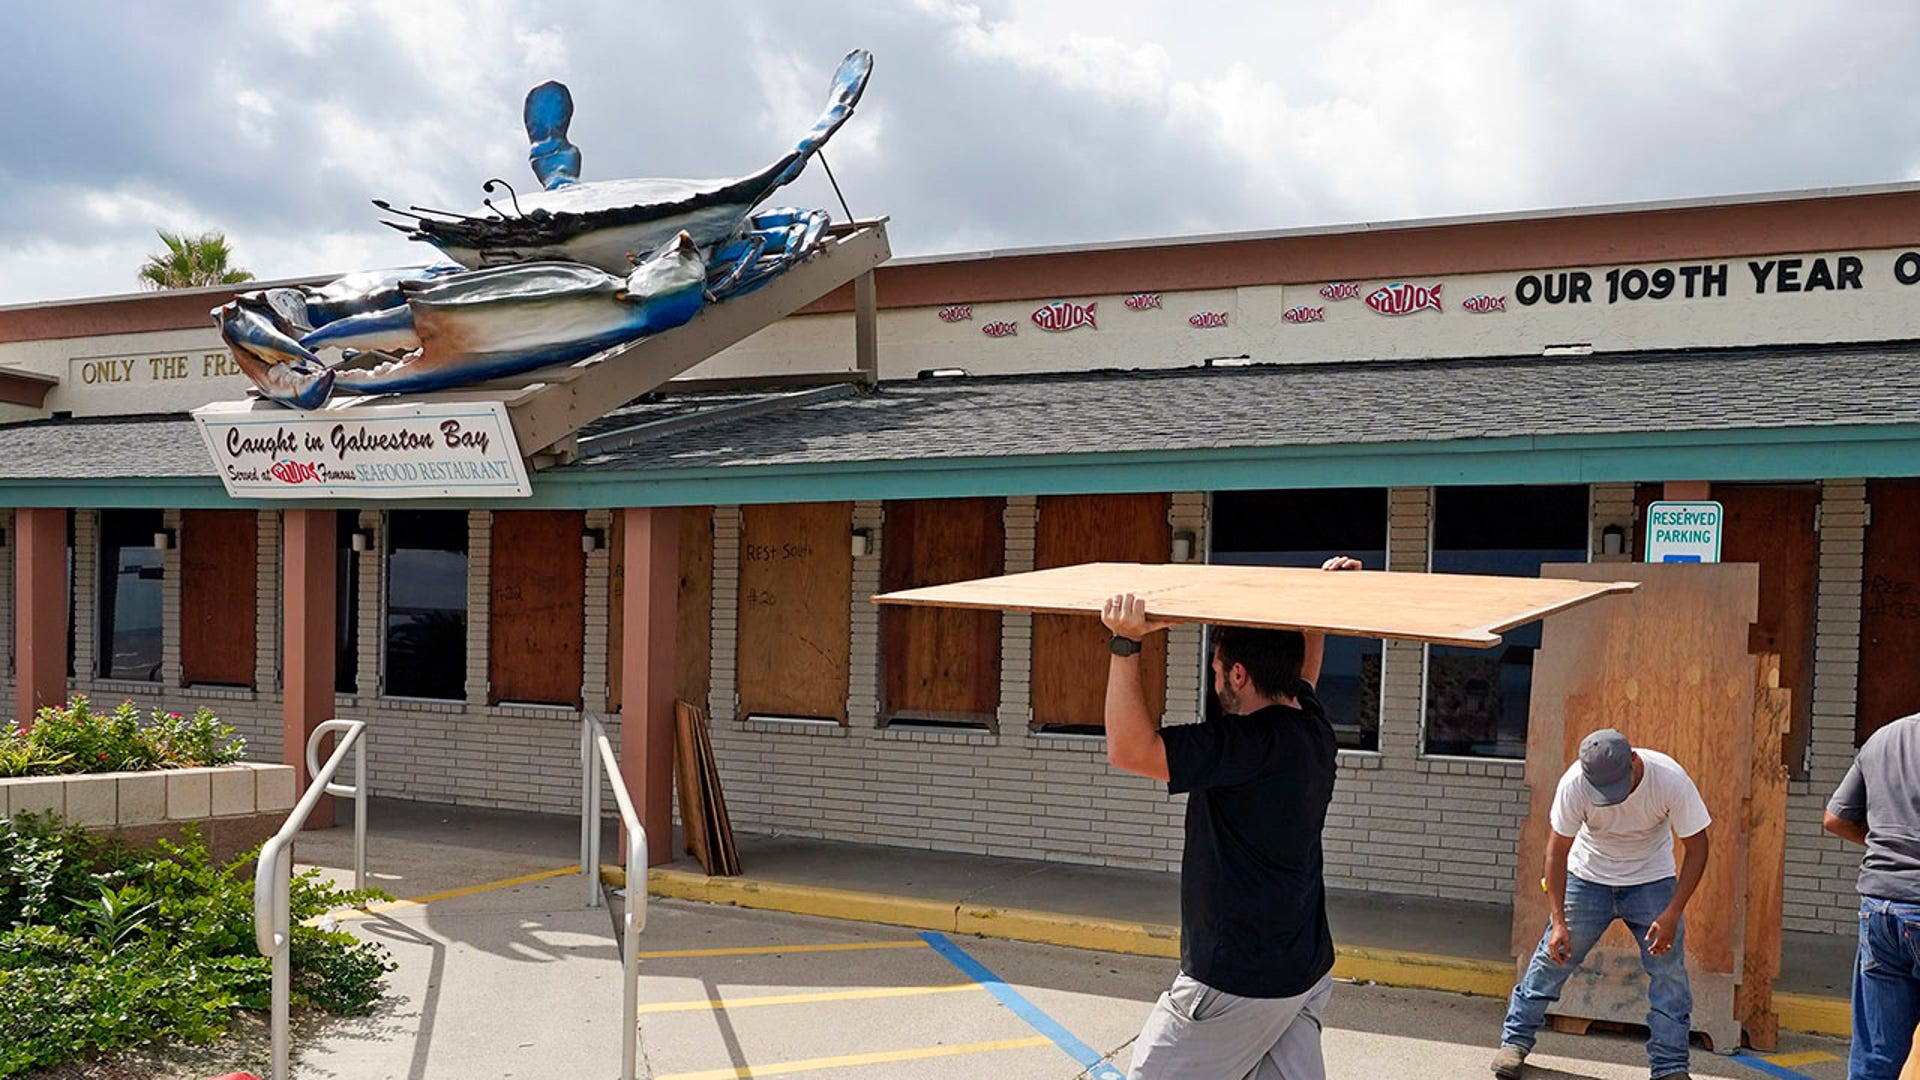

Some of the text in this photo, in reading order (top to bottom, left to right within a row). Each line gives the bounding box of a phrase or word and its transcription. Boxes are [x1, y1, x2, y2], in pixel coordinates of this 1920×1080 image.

[1515, 273, 1592, 306] OUR
[1606, 264, 1728, 304] 109TH
[1748, 257, 1863, 293] YEAR
[82, 360, 135, 384] ONLY
[149, 356, 188, 379] THE
[226, 419, 489, 460] Caught in Galveston Bay
[227, 464, 259, 481] Served
[261, 468, 272, 481] at
[317, 463, 356, 482] Famous
[356, 463, 417, 482] SEAFOOD
[418, 460, 510, 480] RESTAURANT
[1653, 512, 1716, 526] RESERVED
[1656, 530, 1711, 543] PARKING
